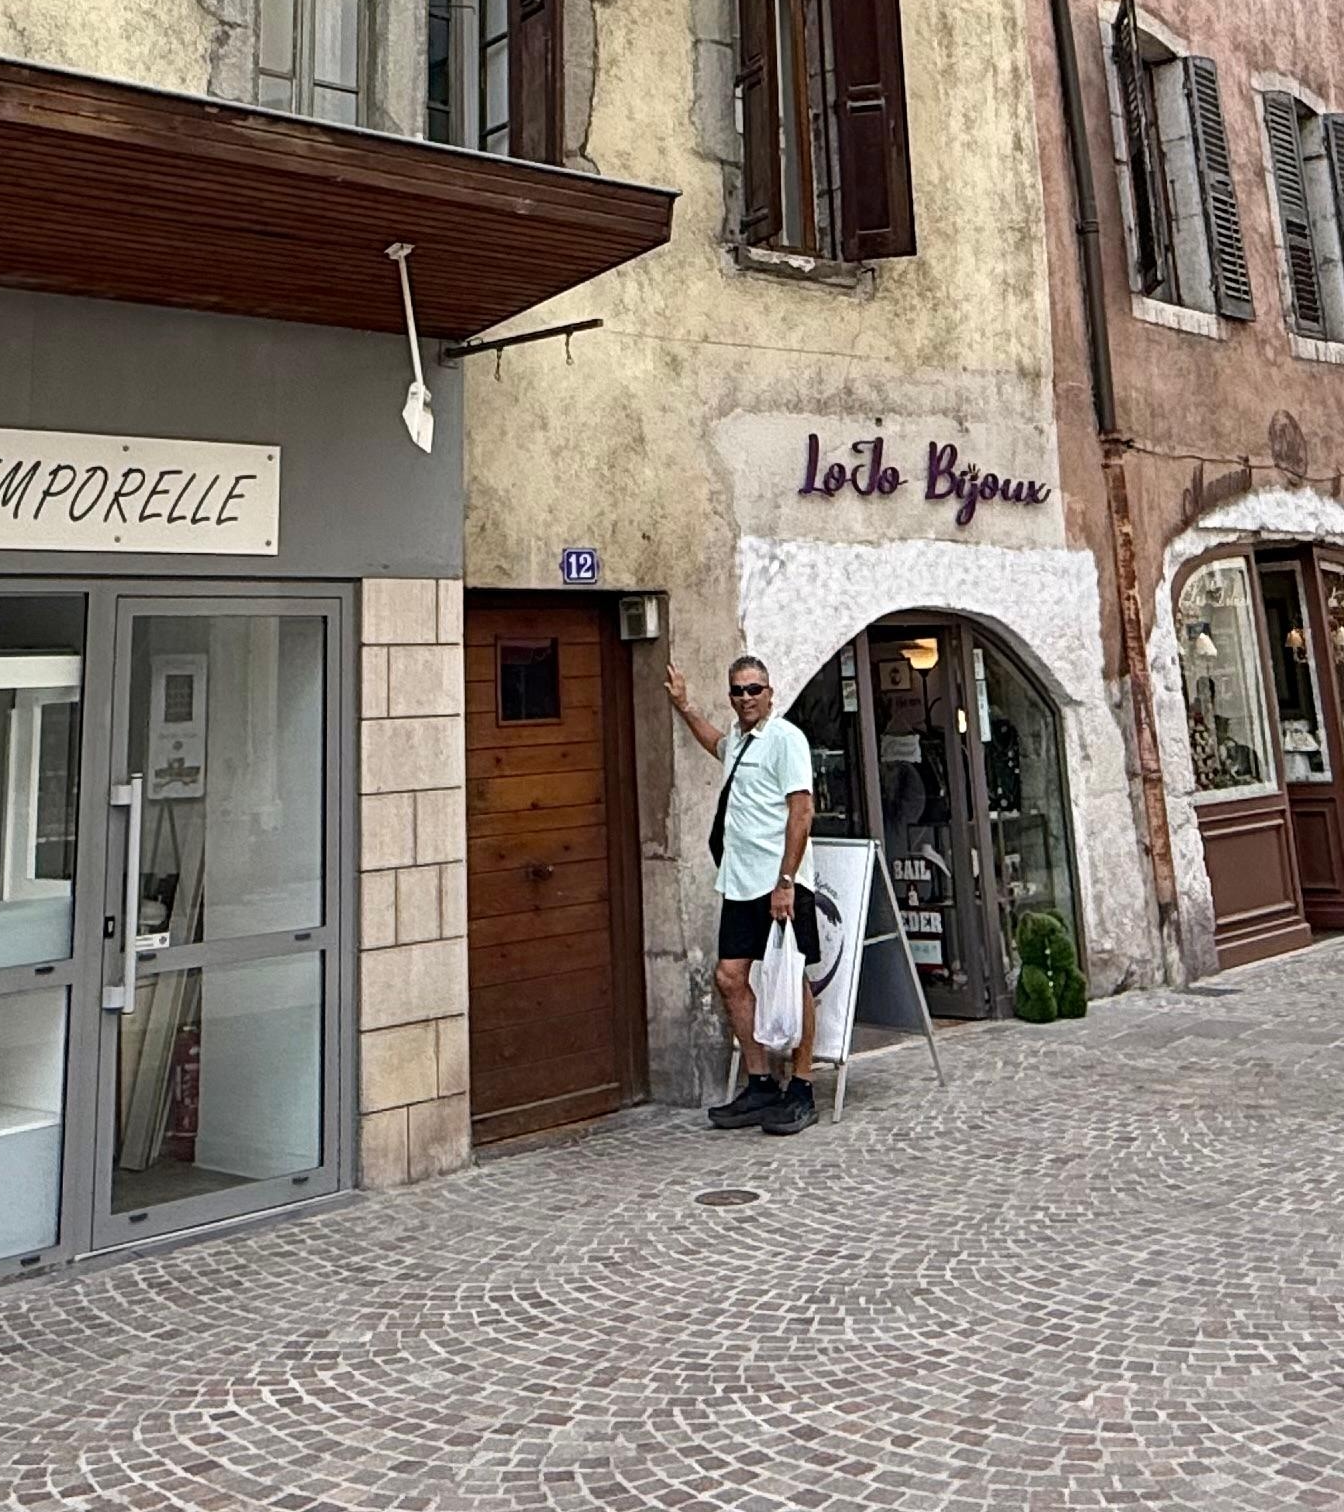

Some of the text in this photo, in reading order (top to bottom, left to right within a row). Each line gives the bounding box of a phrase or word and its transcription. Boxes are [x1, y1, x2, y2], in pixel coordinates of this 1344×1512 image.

[798, 433, 1052, 525] LoJo Bijoux
[568, 553, 592, 578] 12
